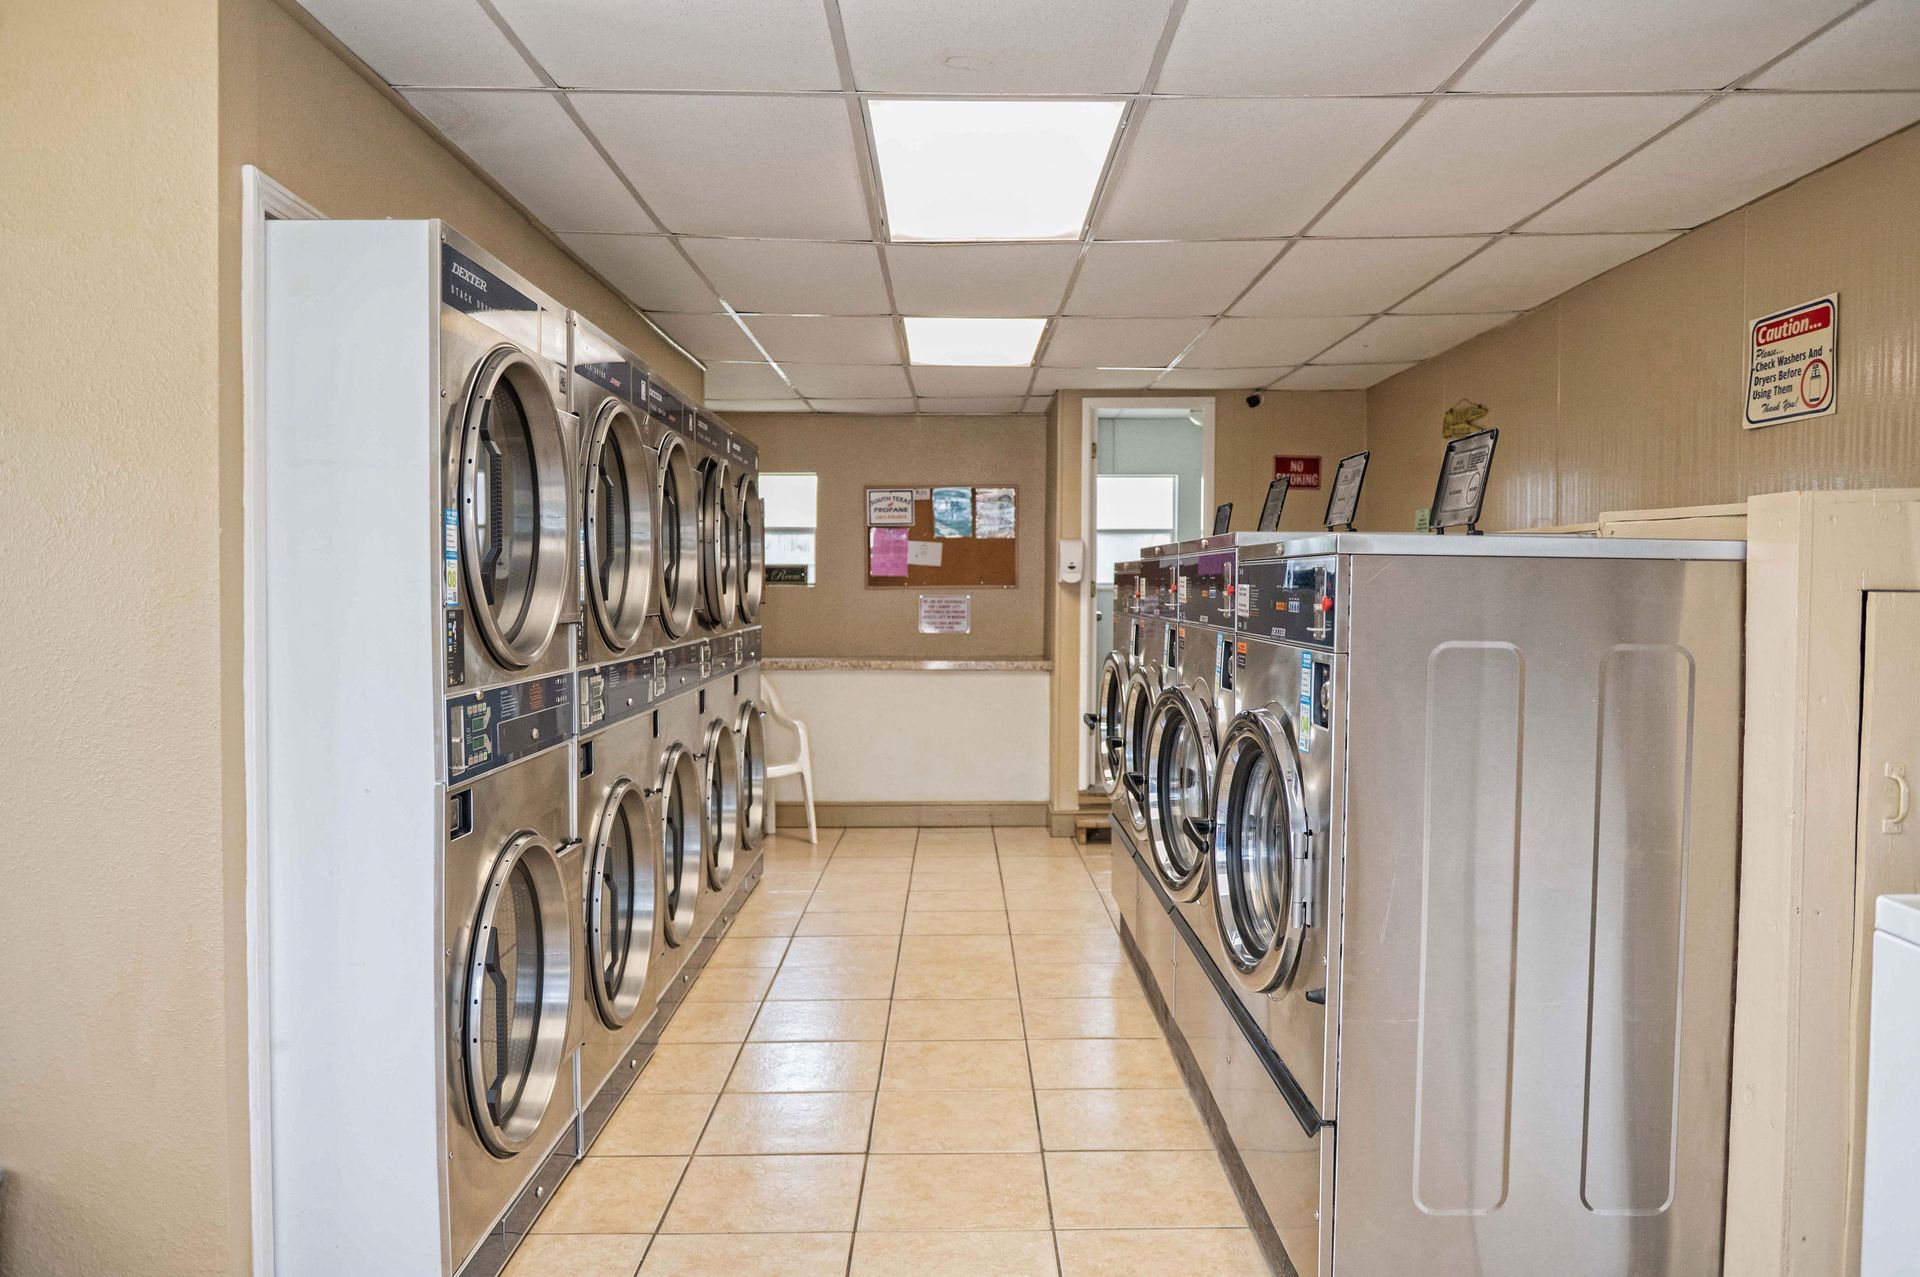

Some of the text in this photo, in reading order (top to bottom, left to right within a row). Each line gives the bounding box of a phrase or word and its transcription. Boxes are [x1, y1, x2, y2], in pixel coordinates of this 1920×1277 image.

[451, 262, 487, 292] DEXTER
[450, 284, 472, 304] STACK
[1757, 318, 1822, 344] Caution...
[1755, 345, 1823, 373] Check Washers And
[1754, 367, 1802, 387] Dryers Before
[1752, 383, 1793, 400] Using Them
[1761, 397, 1799, 414] Thank You!
[1290, 460, 1304, 472] NO
[870, 496, 911, 505] SOUTH TEXAS
